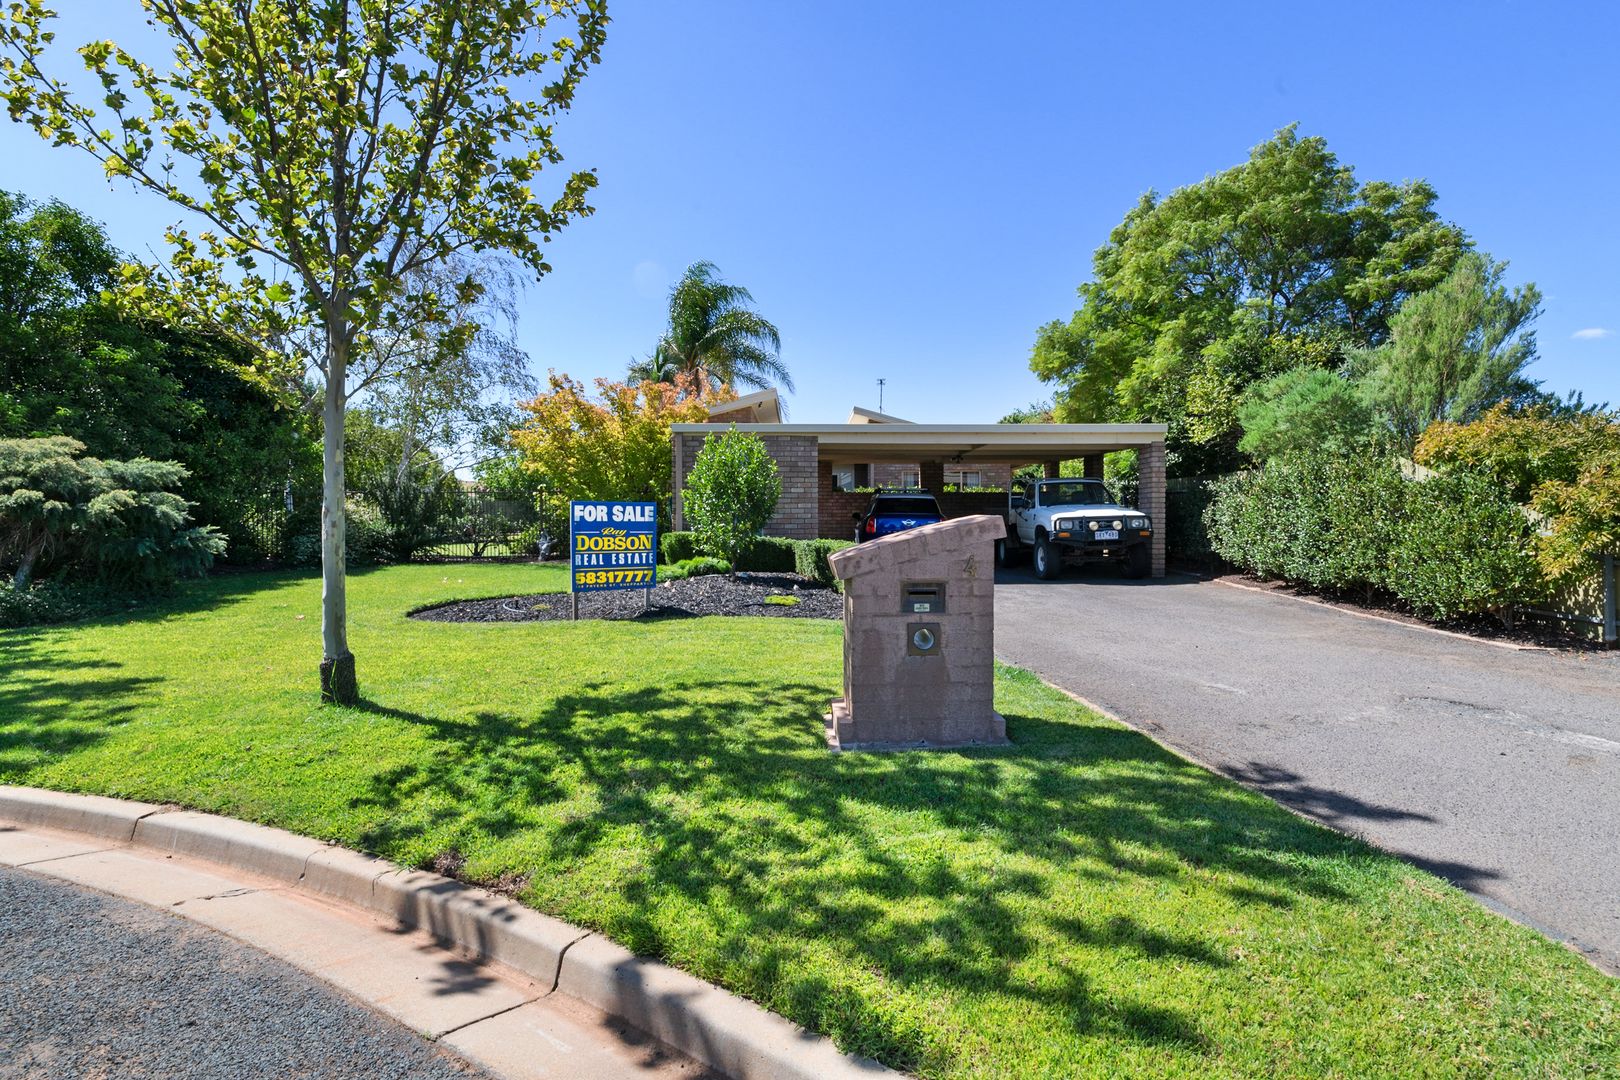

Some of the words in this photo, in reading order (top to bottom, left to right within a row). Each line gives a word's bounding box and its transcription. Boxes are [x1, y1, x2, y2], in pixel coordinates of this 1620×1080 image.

[574, 505, 608, 522] FOR
[612, 505, 654, 522] SALE
[575, 534, 653, 551] DOBSON
[575, 554, 604, 566] REAL
[612, 553, 654, 564] ESTATE
[963, 554, 978, 577] 4
[575, 570, 654, 585] 58317777
